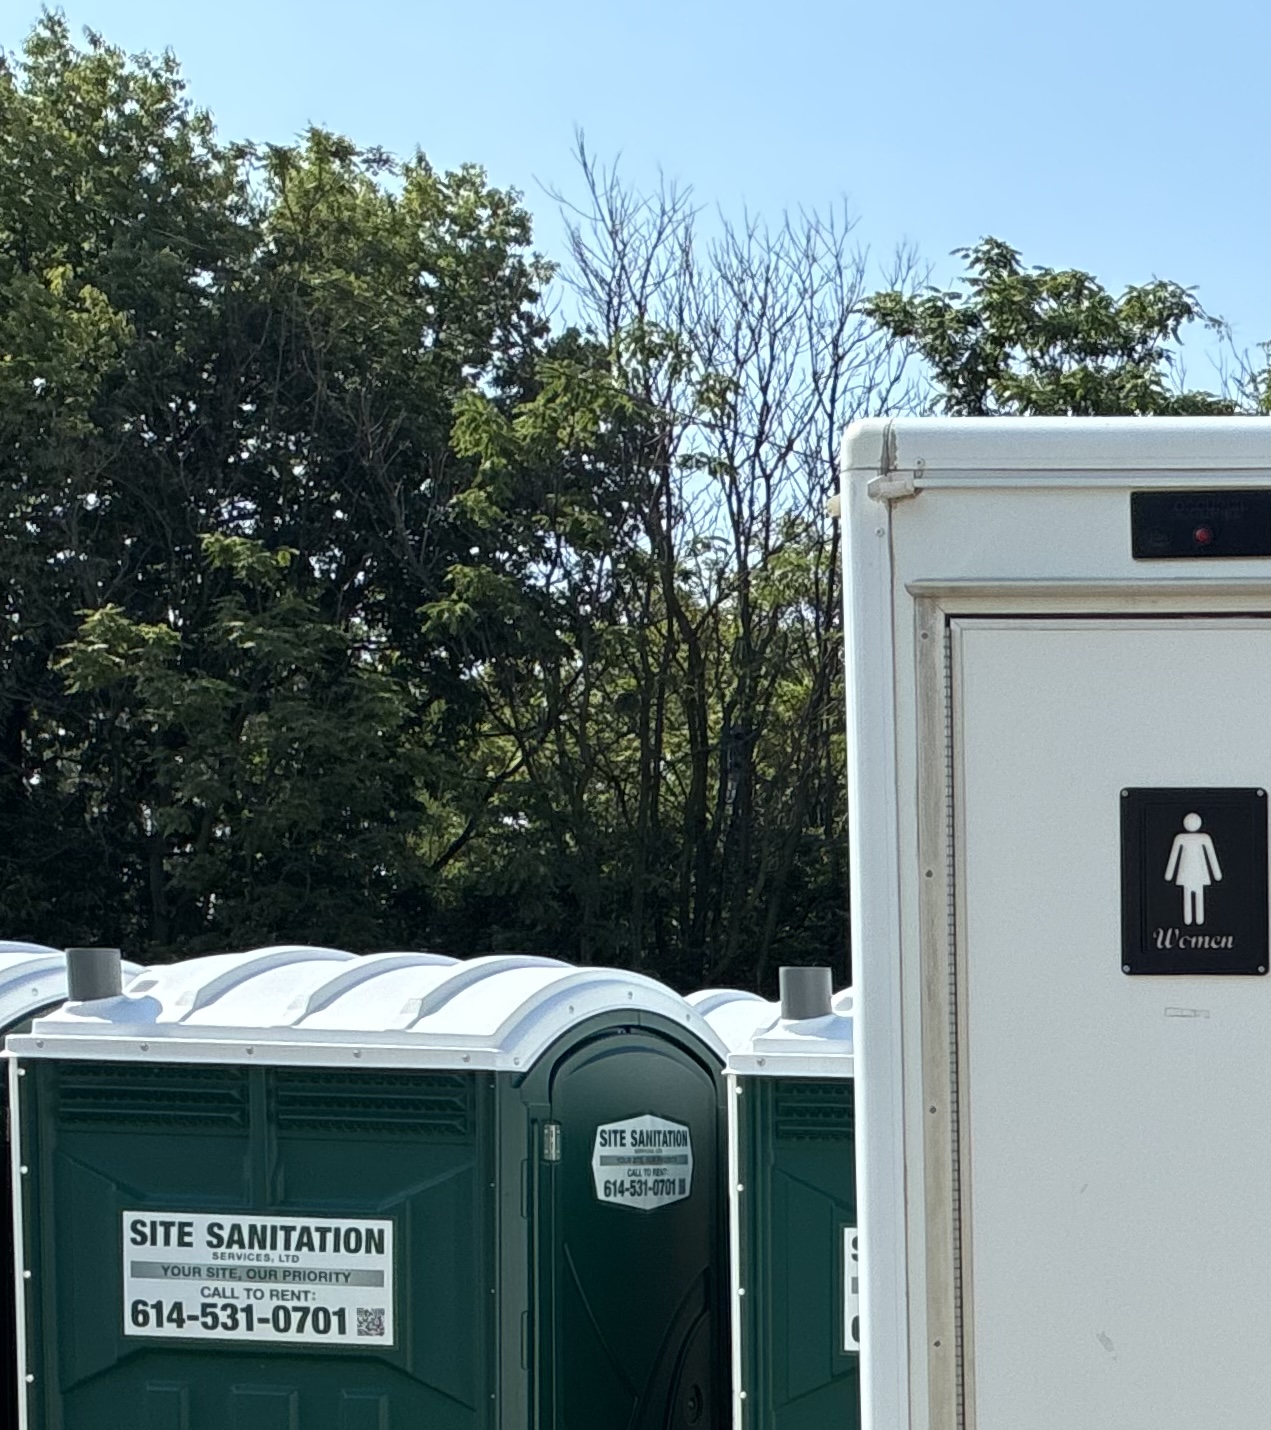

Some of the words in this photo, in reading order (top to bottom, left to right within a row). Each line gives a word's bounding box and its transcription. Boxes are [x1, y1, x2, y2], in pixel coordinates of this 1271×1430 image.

[1153, 928, 1234, 949] Women
[599, 1129, 626, 1147] SITE
[631, 1129, 688, 1147] SANITATION
[627, 1168, 642, 1177] CALL
[643, 1168, 652, 1177] TO
[604, 1179, 676, 1197] 614-531-0701
[130, 1219, 194, 1248] SITE
[206, 1222, 385, 1254] SANITATION
[212, 1251, 275, 1263] SERVICES,
[278, 1253, 300, 1263] LTD
[161, 1265, 202, 1278] YOUR
[206, 1267, 242, 1280] SITE,
[246, 1268, 278, 1281] OUR
[283, 1270, 351, 1283] PRIORITY
[200, 1286, 239, 1299] CALL
[244, 1288, 265, 1300] TO
[269, 1289, 316, 1301] RENT:
[131, 1300, 347, 1335] 614-531-0701
